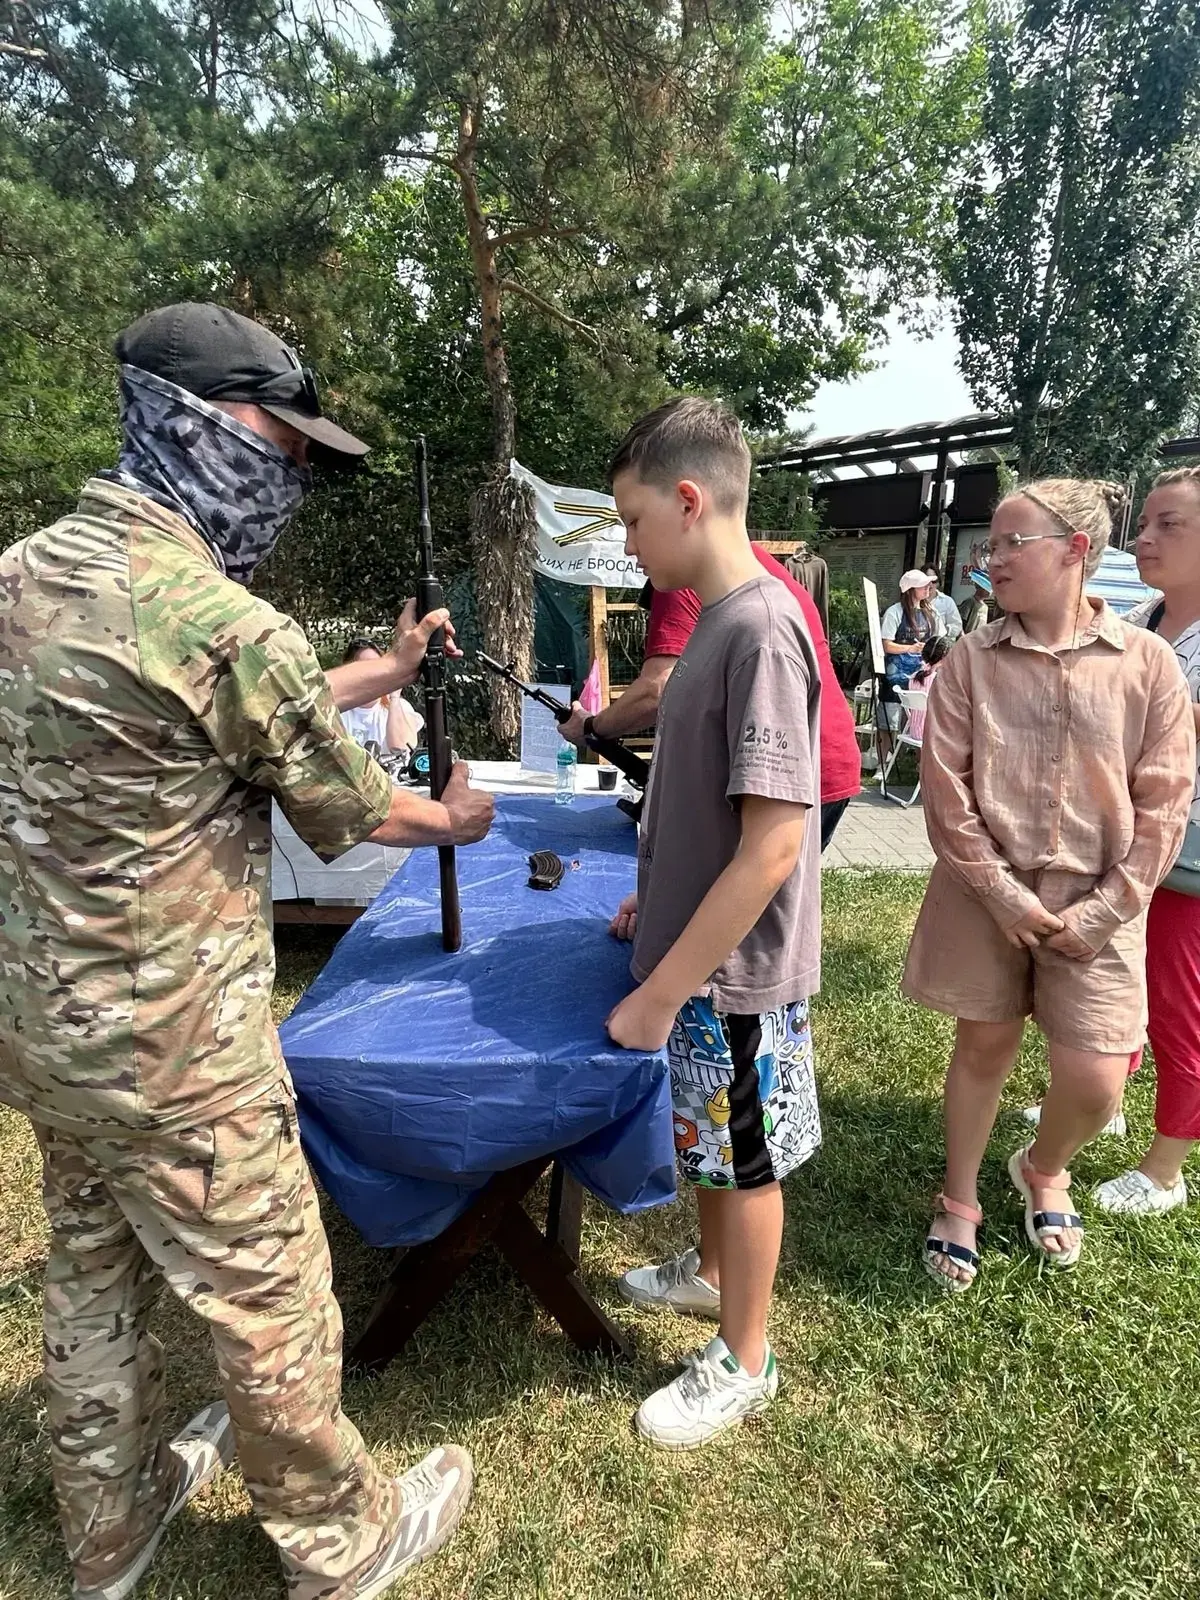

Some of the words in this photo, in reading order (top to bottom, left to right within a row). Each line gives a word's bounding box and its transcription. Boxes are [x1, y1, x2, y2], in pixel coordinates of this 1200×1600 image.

[568, 558, 584, 571] НЕ
[744, 725, 771, 746] 2,5
[775, 730, 788, 750] %
